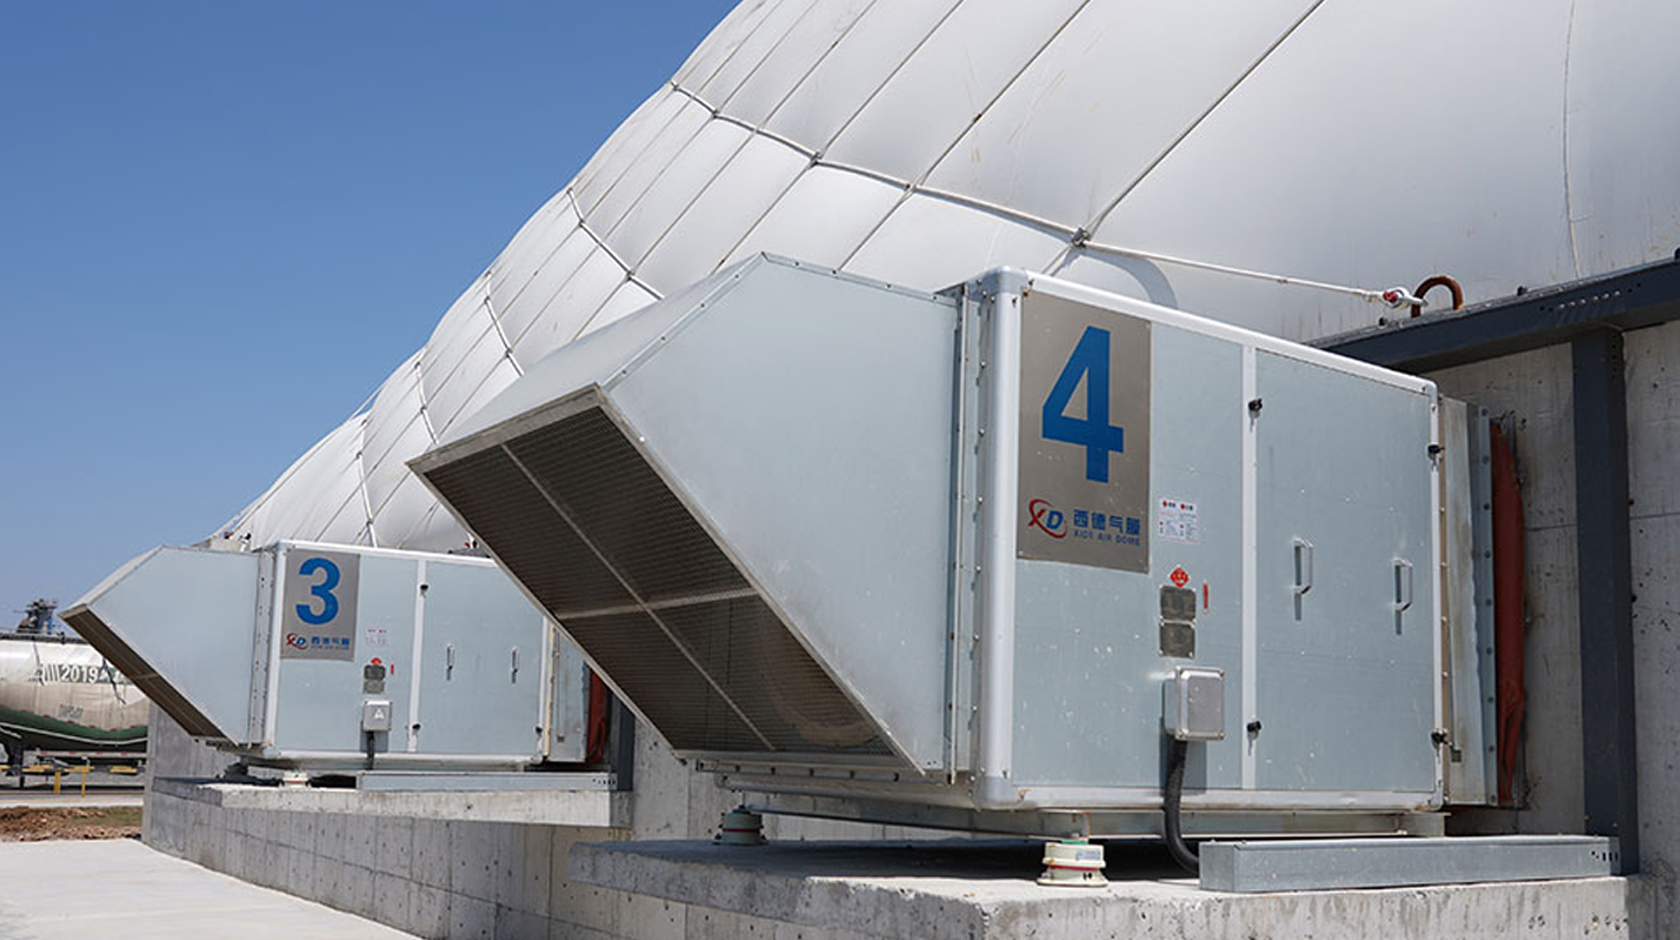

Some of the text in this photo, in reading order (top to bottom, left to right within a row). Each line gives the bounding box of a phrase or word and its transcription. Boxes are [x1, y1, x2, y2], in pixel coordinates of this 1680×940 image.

[1042, 326, 1124, 483] 4
[1073, 509, 1140, 535] 西德气膜
[295, 557, 341, 625] 3
[61, 664, 99, 684] 2019
